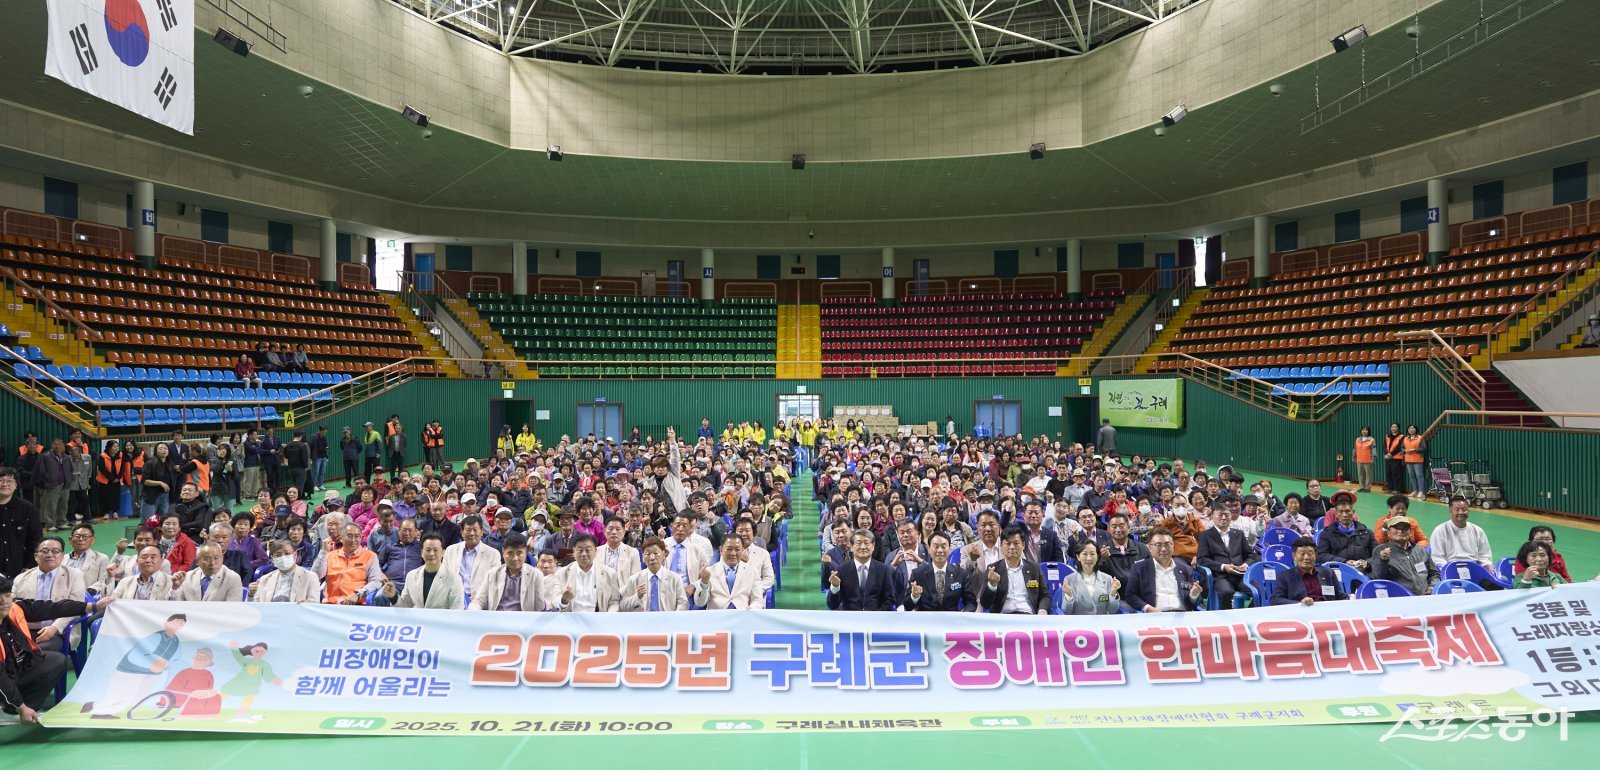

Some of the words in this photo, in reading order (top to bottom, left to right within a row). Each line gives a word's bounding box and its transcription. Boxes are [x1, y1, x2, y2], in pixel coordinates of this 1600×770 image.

[1428, 210, 1437, 221] 자
[884, 268, 892, 276] 아
[1290, 405, 1297, 415] A
[286, 414, 293, 424] A
[1526, 601, 1569, 620] 경품
[1567, 599, 1592, 617] 및
[349, 623, 421, 643] 장애인
[471, 632, 730, 689] 2025년
[750, 631, 925, 688] 구례군
[944, 629, 1123, 687] 장애인
[1137, 611, 1501, 681] 한마음대축제
[319, 648, 440, 670] 비장애인이
[294, 676, 347, 696] 함께
[353, 676, 451, 697] 어울리는
[332, 718, 375, 728] 일시
[390, 721, 461, 731] 2025.
[469, 720, 504, 731] 10.
[598, 721, 673, 731] 10:00
